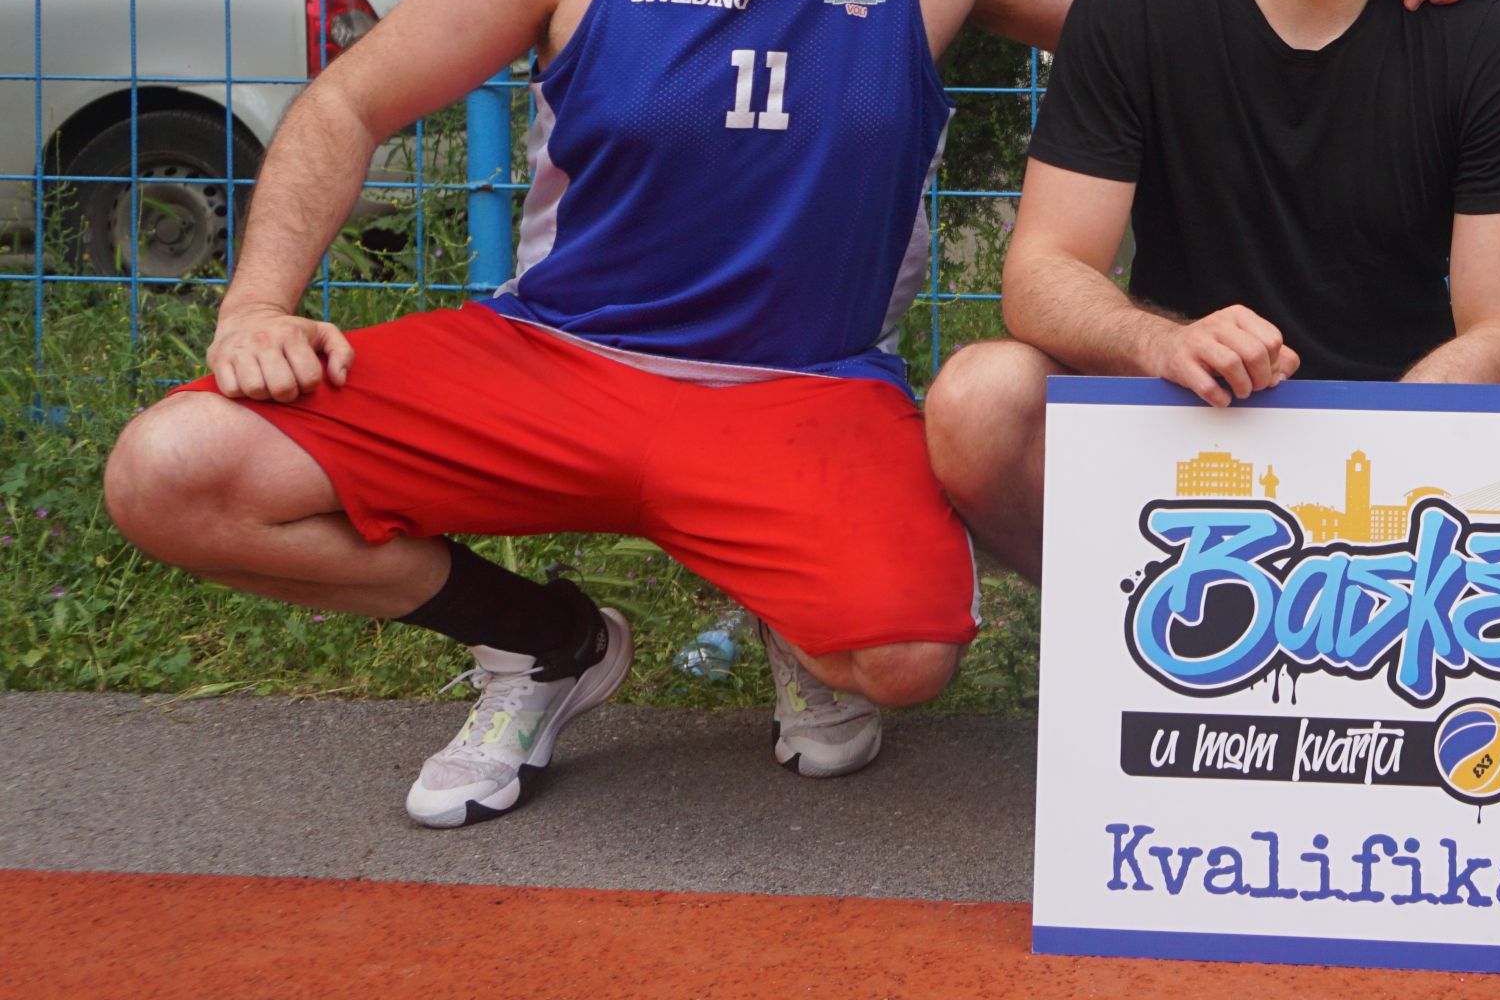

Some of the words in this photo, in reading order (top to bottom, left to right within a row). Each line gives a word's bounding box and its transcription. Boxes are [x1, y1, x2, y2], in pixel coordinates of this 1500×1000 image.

[725, 49, 790, 131] 11
[1149, 728, 1180, 768] u
[1192, 723, 1279, 774] mom
[1292, 717, 1405, 786] kvartu
